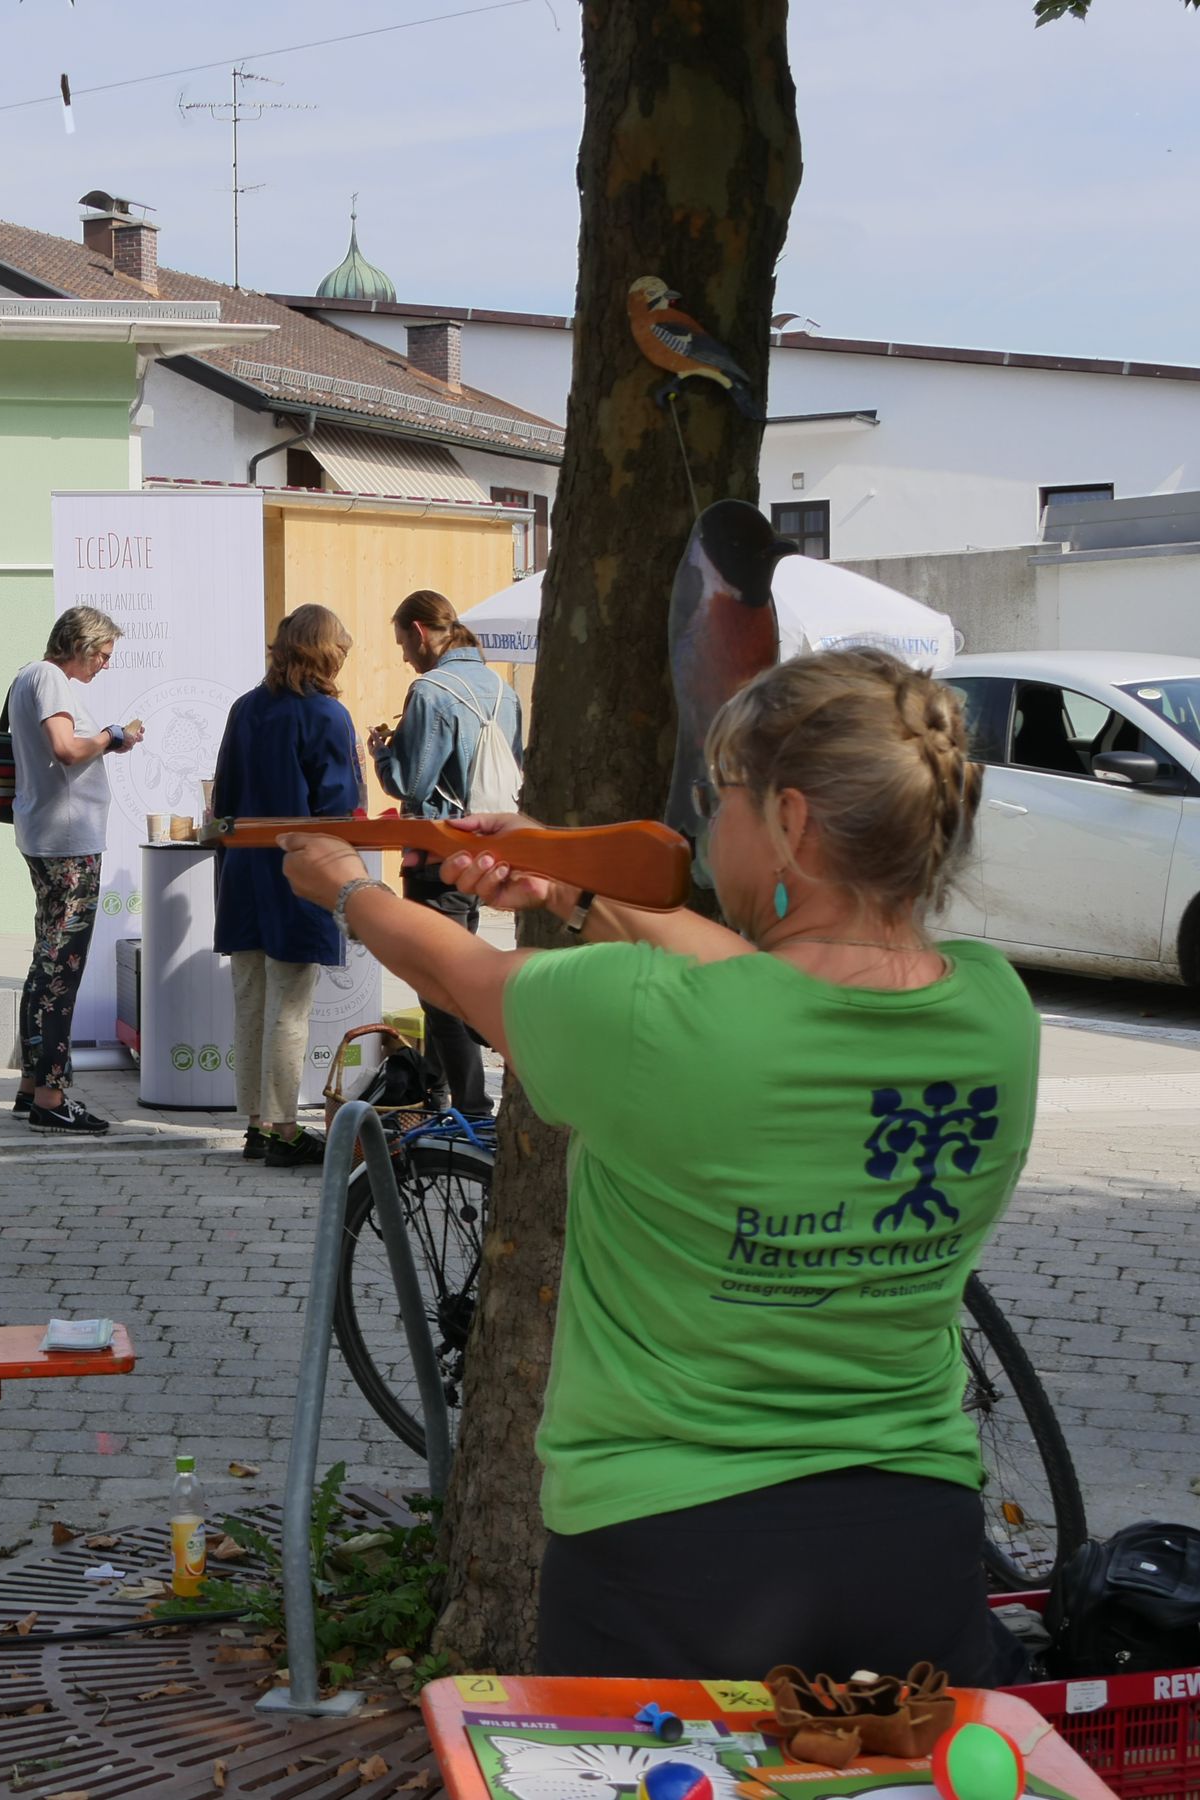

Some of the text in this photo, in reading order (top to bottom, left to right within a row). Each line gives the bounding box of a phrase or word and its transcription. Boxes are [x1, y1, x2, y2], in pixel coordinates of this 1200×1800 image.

[736, 1201, 846, 1238] Bund
[727, 1233, 963, 1269] Naturschutz
[479, 1718, 559, 1730] WILDE KATZE
